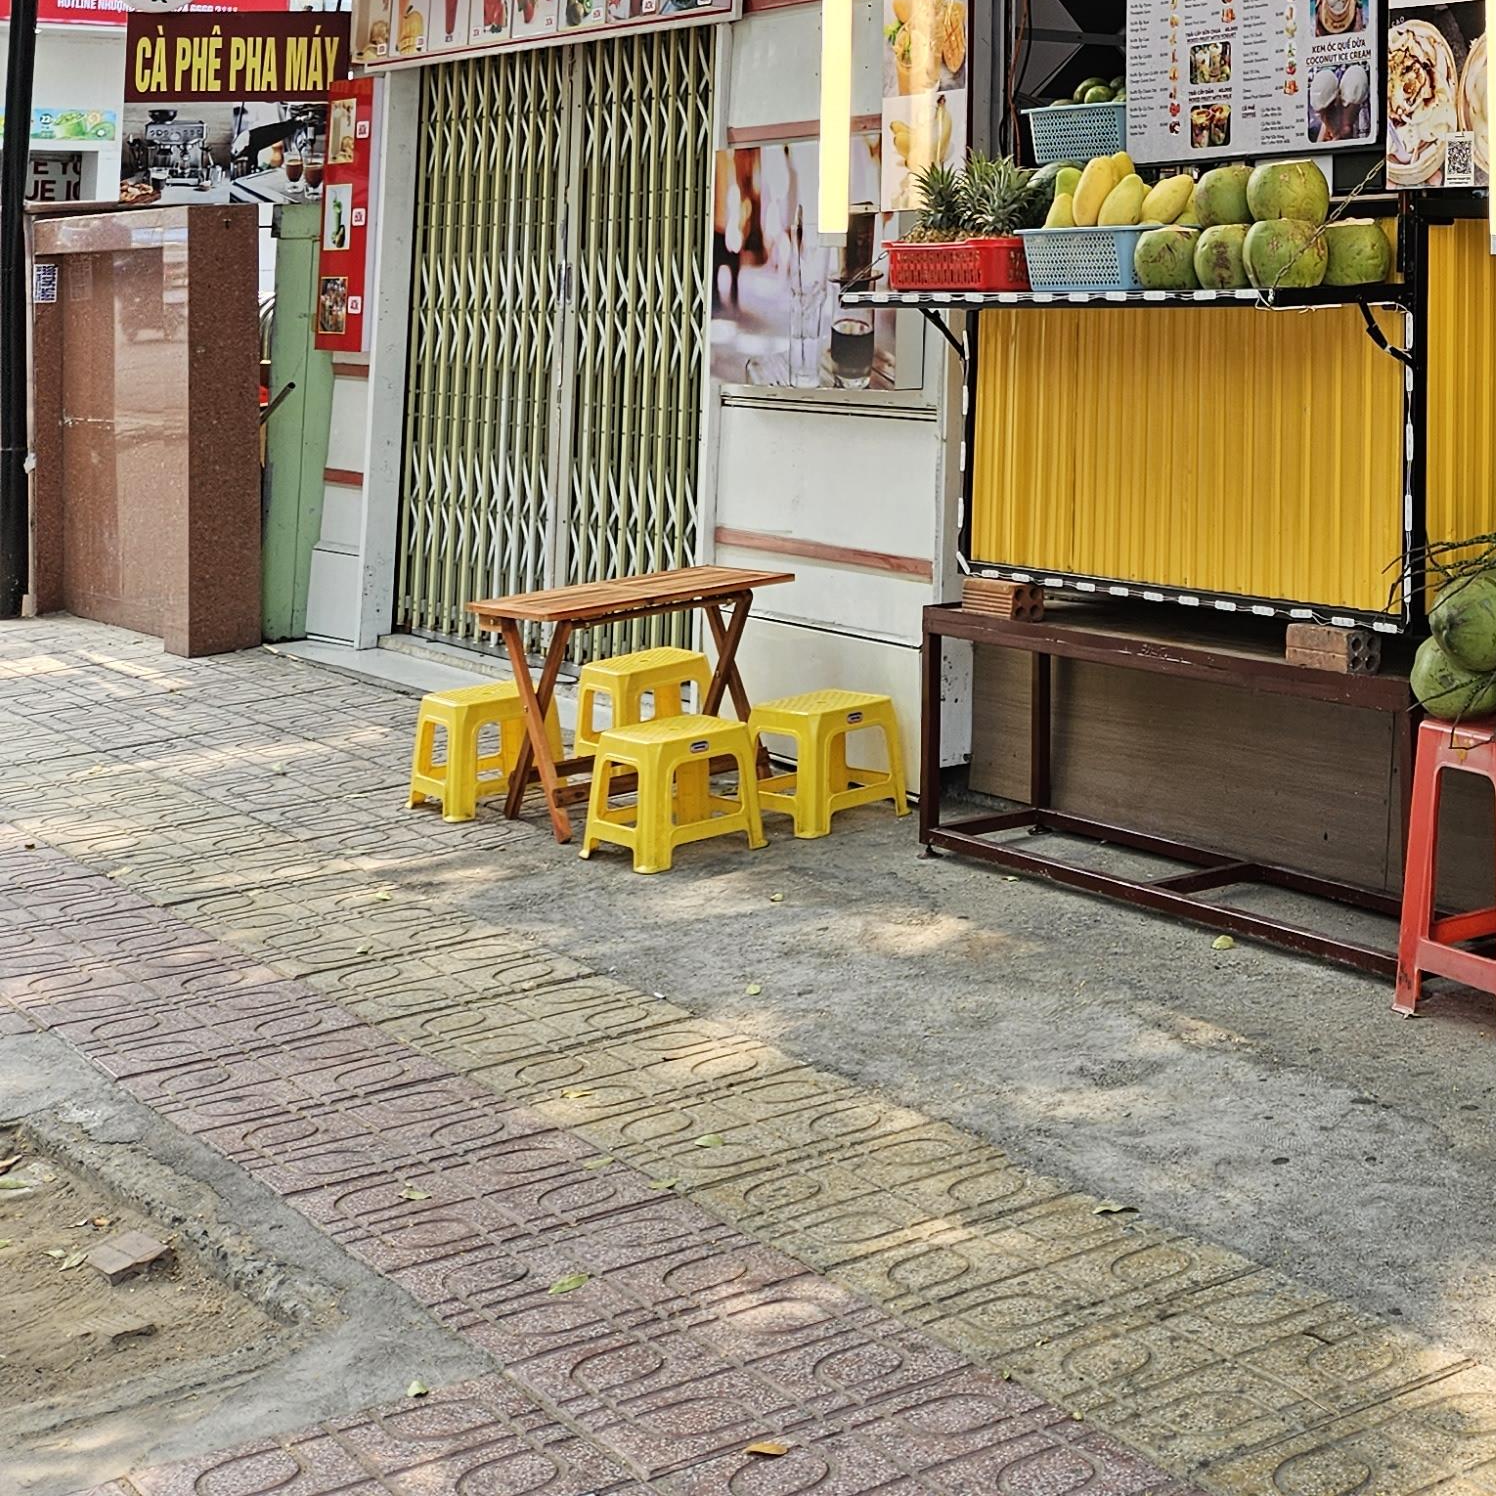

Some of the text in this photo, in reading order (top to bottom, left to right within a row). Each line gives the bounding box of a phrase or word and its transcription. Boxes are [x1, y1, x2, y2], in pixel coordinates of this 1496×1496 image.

[135, 25, 340, 93] CÀ PHÊ PHA MÁY
[1305, 52, 1337, 65] COCONUT
